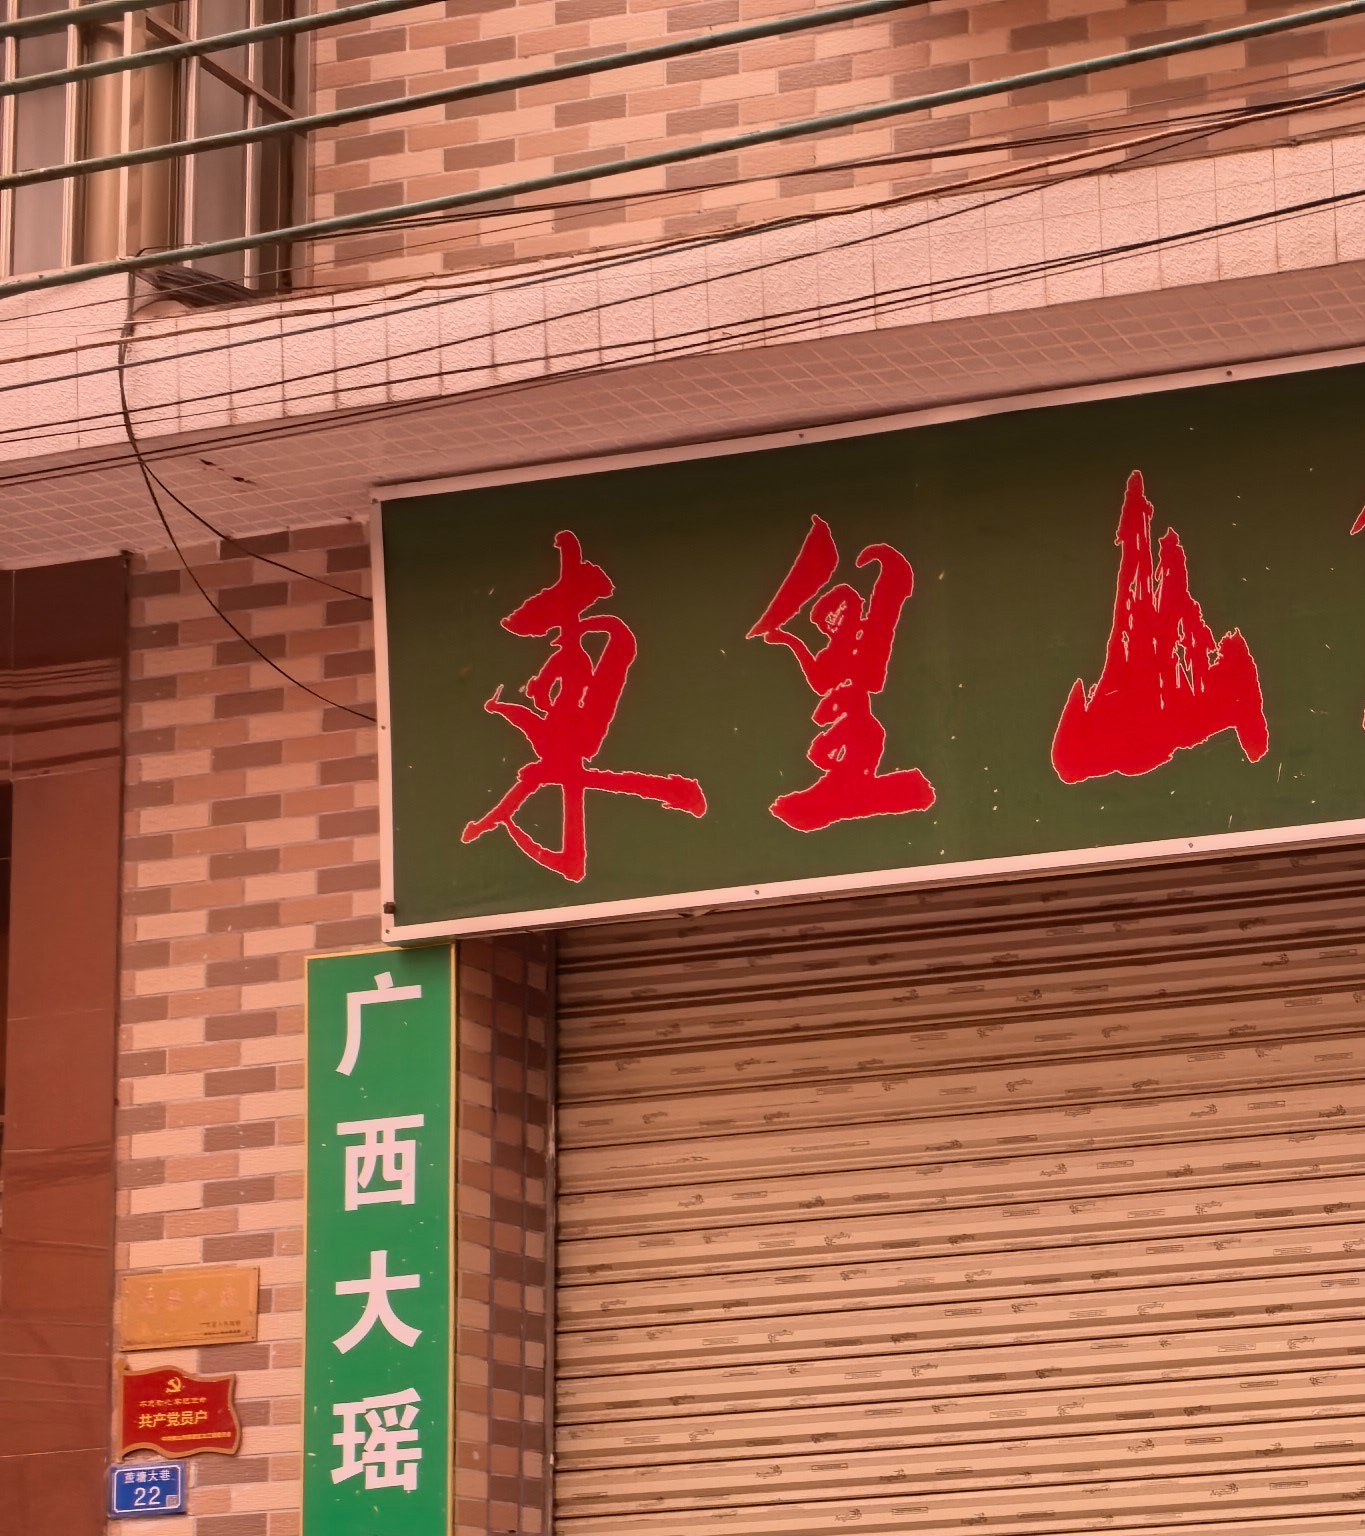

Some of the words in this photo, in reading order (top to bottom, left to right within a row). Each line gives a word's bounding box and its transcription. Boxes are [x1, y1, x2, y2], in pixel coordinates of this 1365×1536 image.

[138, 1409, 208, 1429] 共产党员户
[134, 1485, 161, 1507] 22
